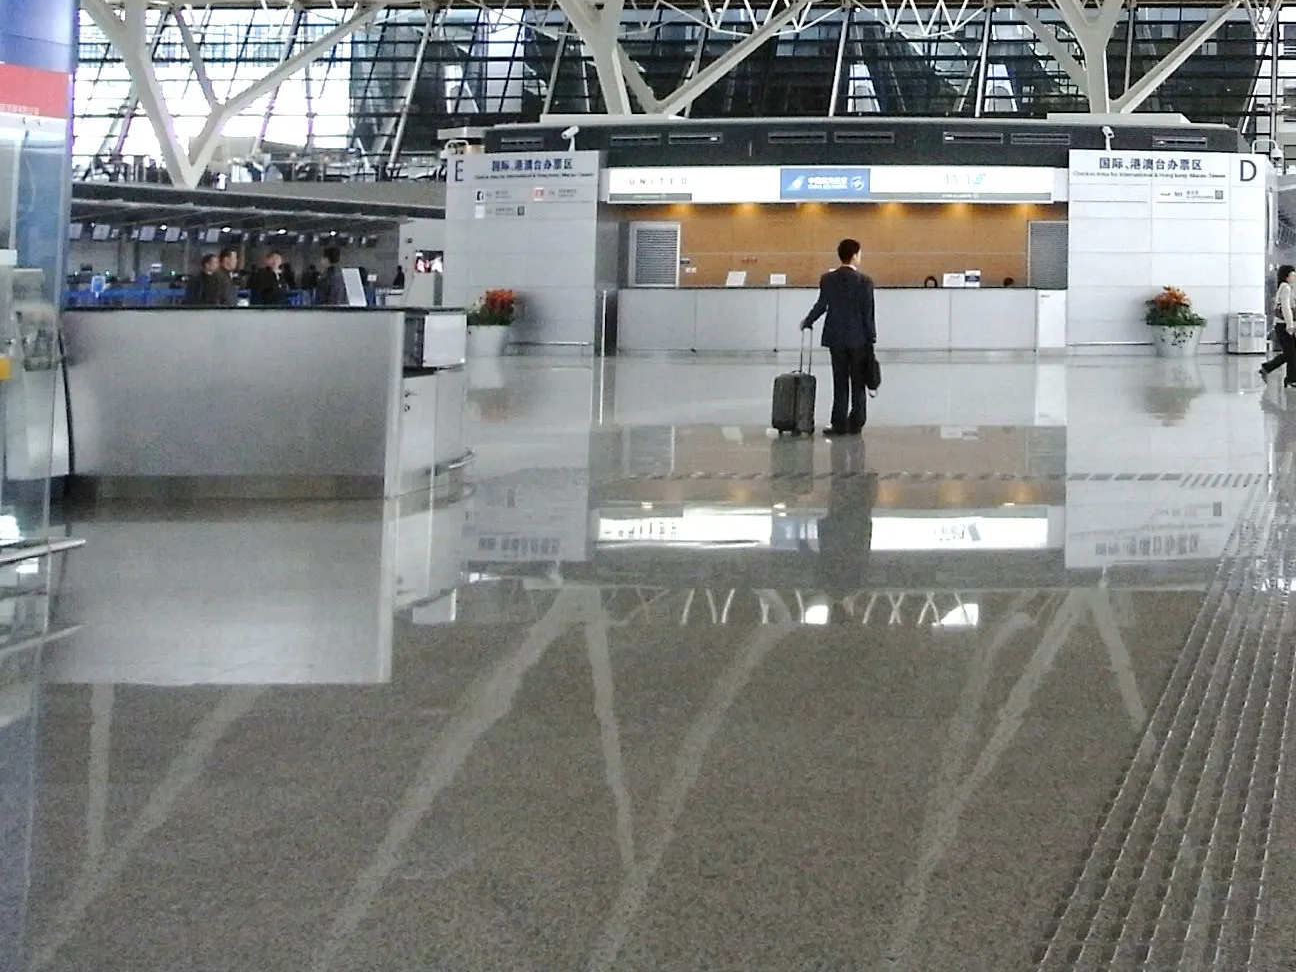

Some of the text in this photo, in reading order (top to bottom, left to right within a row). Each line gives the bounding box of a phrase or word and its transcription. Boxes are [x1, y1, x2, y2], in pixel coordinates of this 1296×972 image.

[455, 159, 464, 182] E
[1099, 157, 1202, 171] 国际、港澳台办票区
[1239, 159, 1257, 182] D
[629, 177, 687, 185] UNITED
